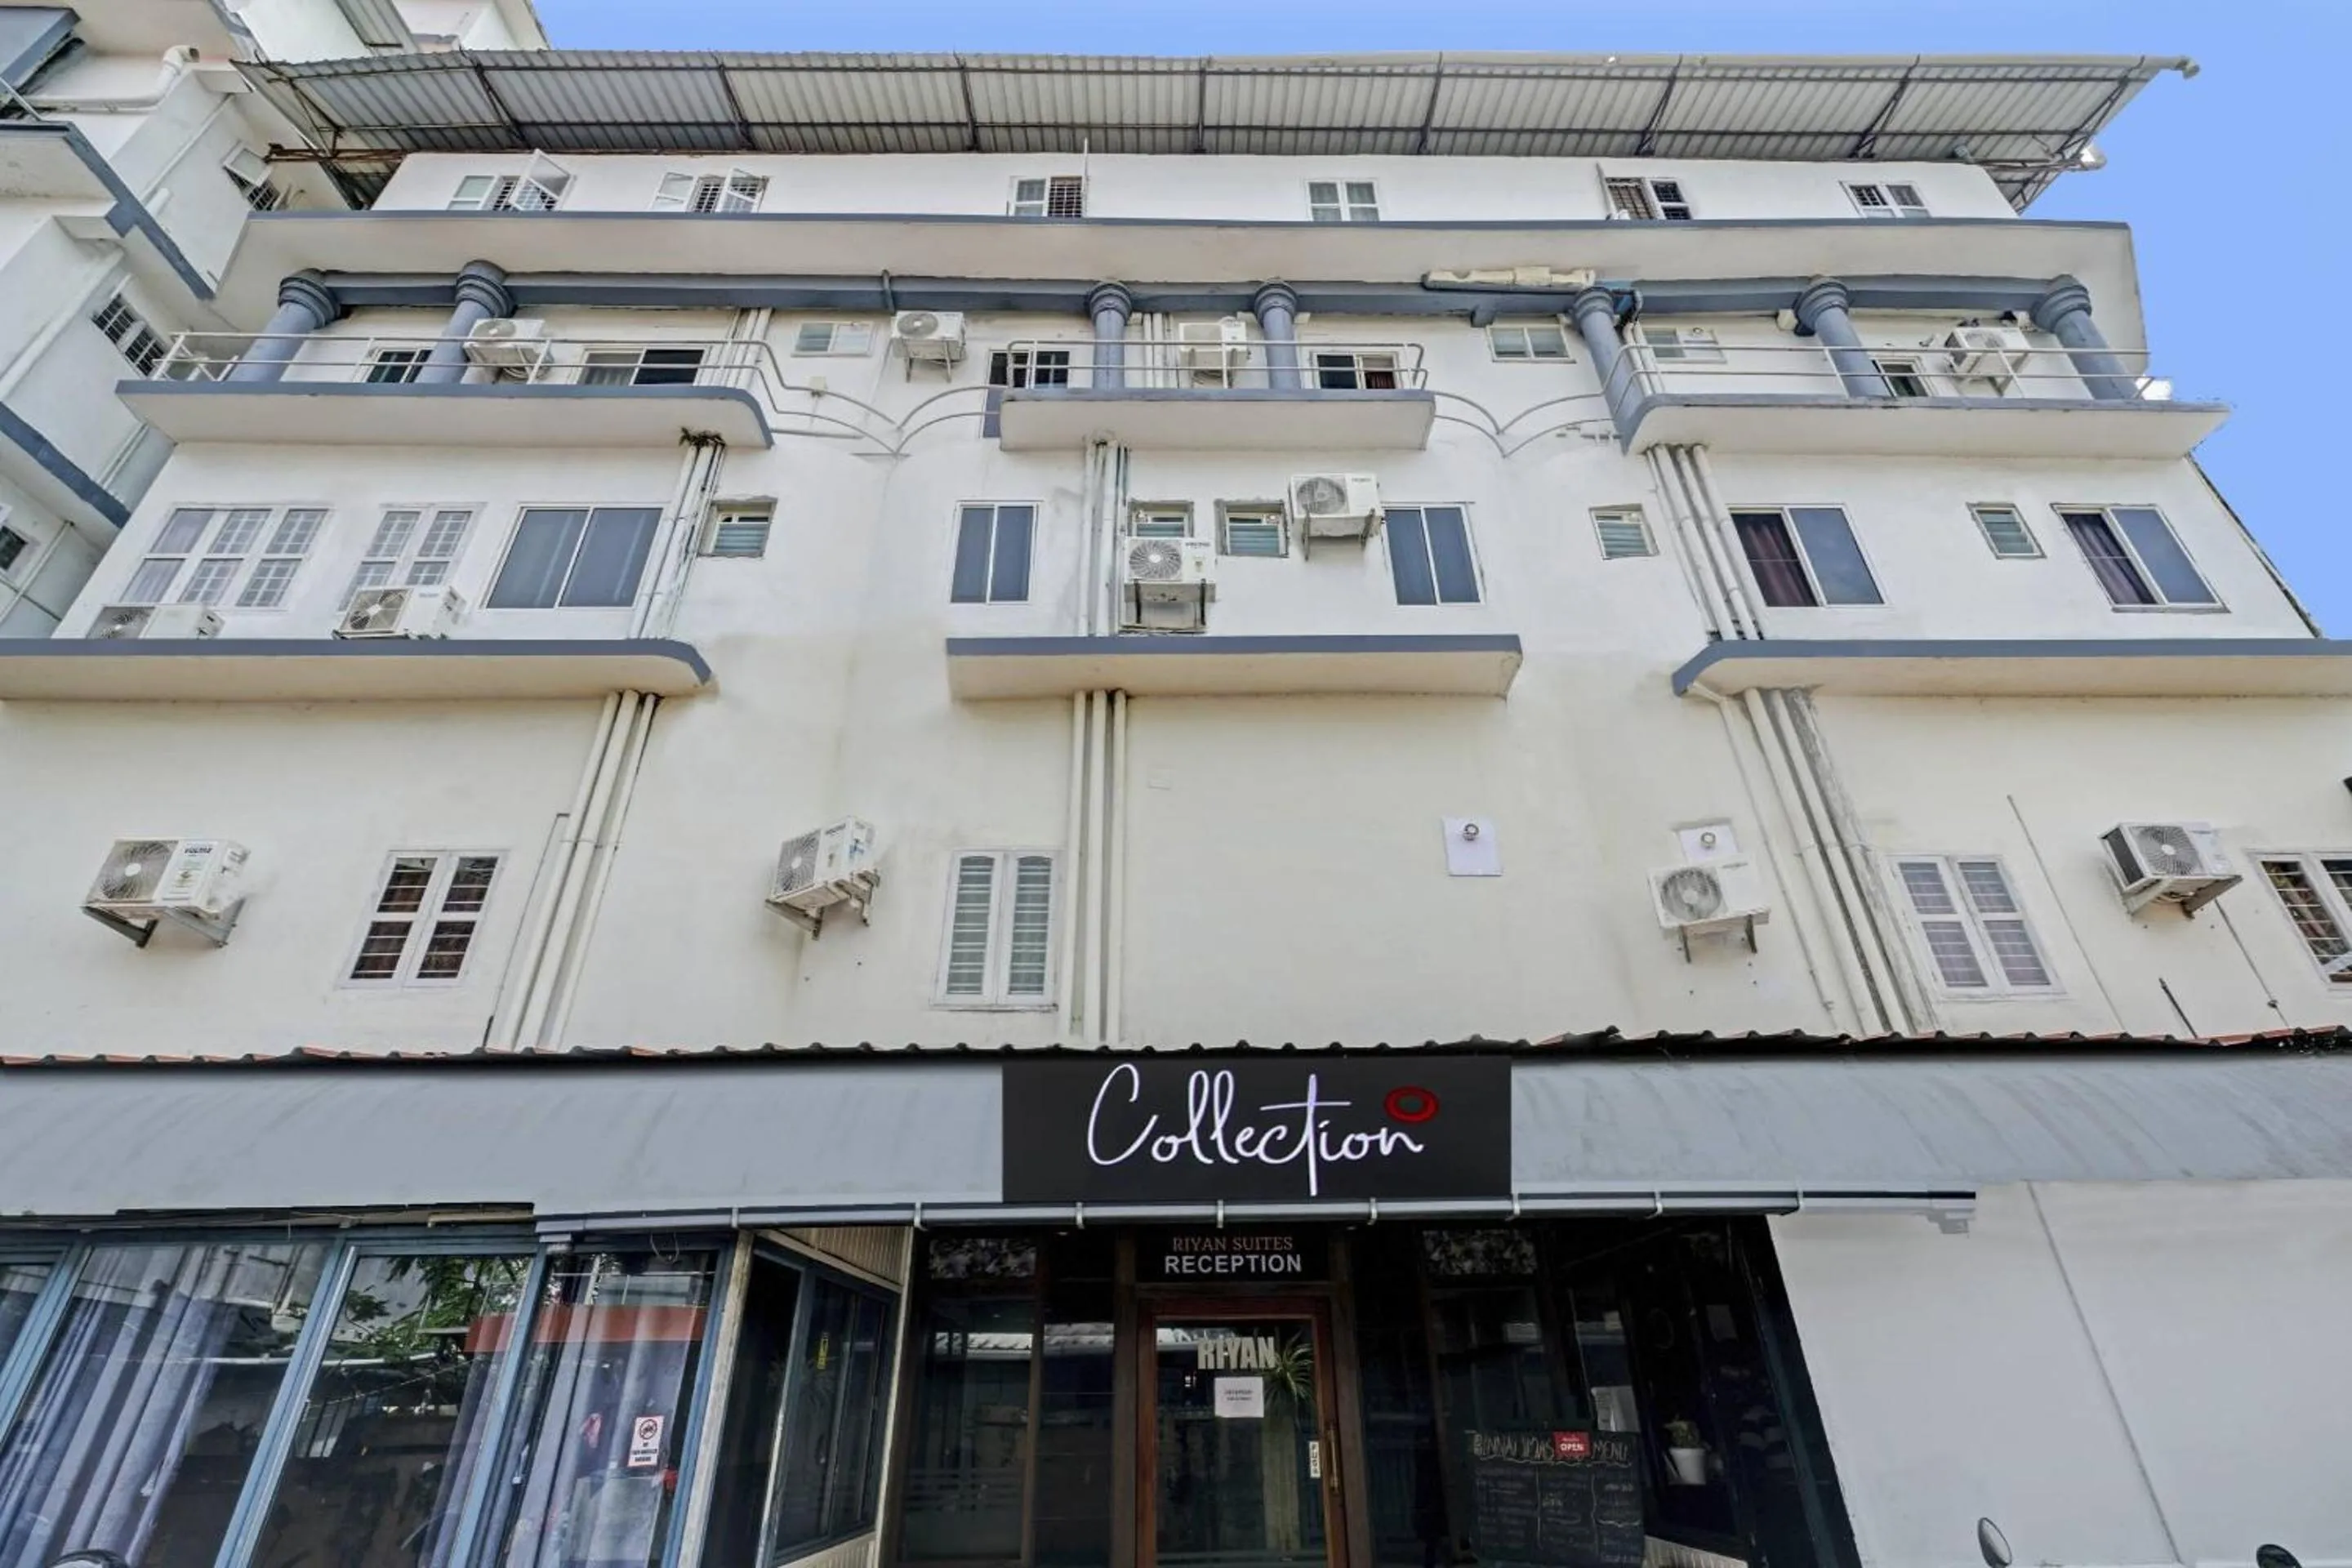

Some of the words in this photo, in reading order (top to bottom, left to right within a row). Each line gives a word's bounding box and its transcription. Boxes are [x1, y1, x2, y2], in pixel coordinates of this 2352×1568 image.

[1087, 1063, 1424, 1196] Collection
[1172, 1236, 1227, 1252] RIYAN
[1232, 1236, 1294, 1250] SUITES
[1164, 1254, 1303, 1274] RECEPTION
[1197, 1336, 1276, 1370] RIYAN
[1560, 1443, 1585, 1451] OPEN
